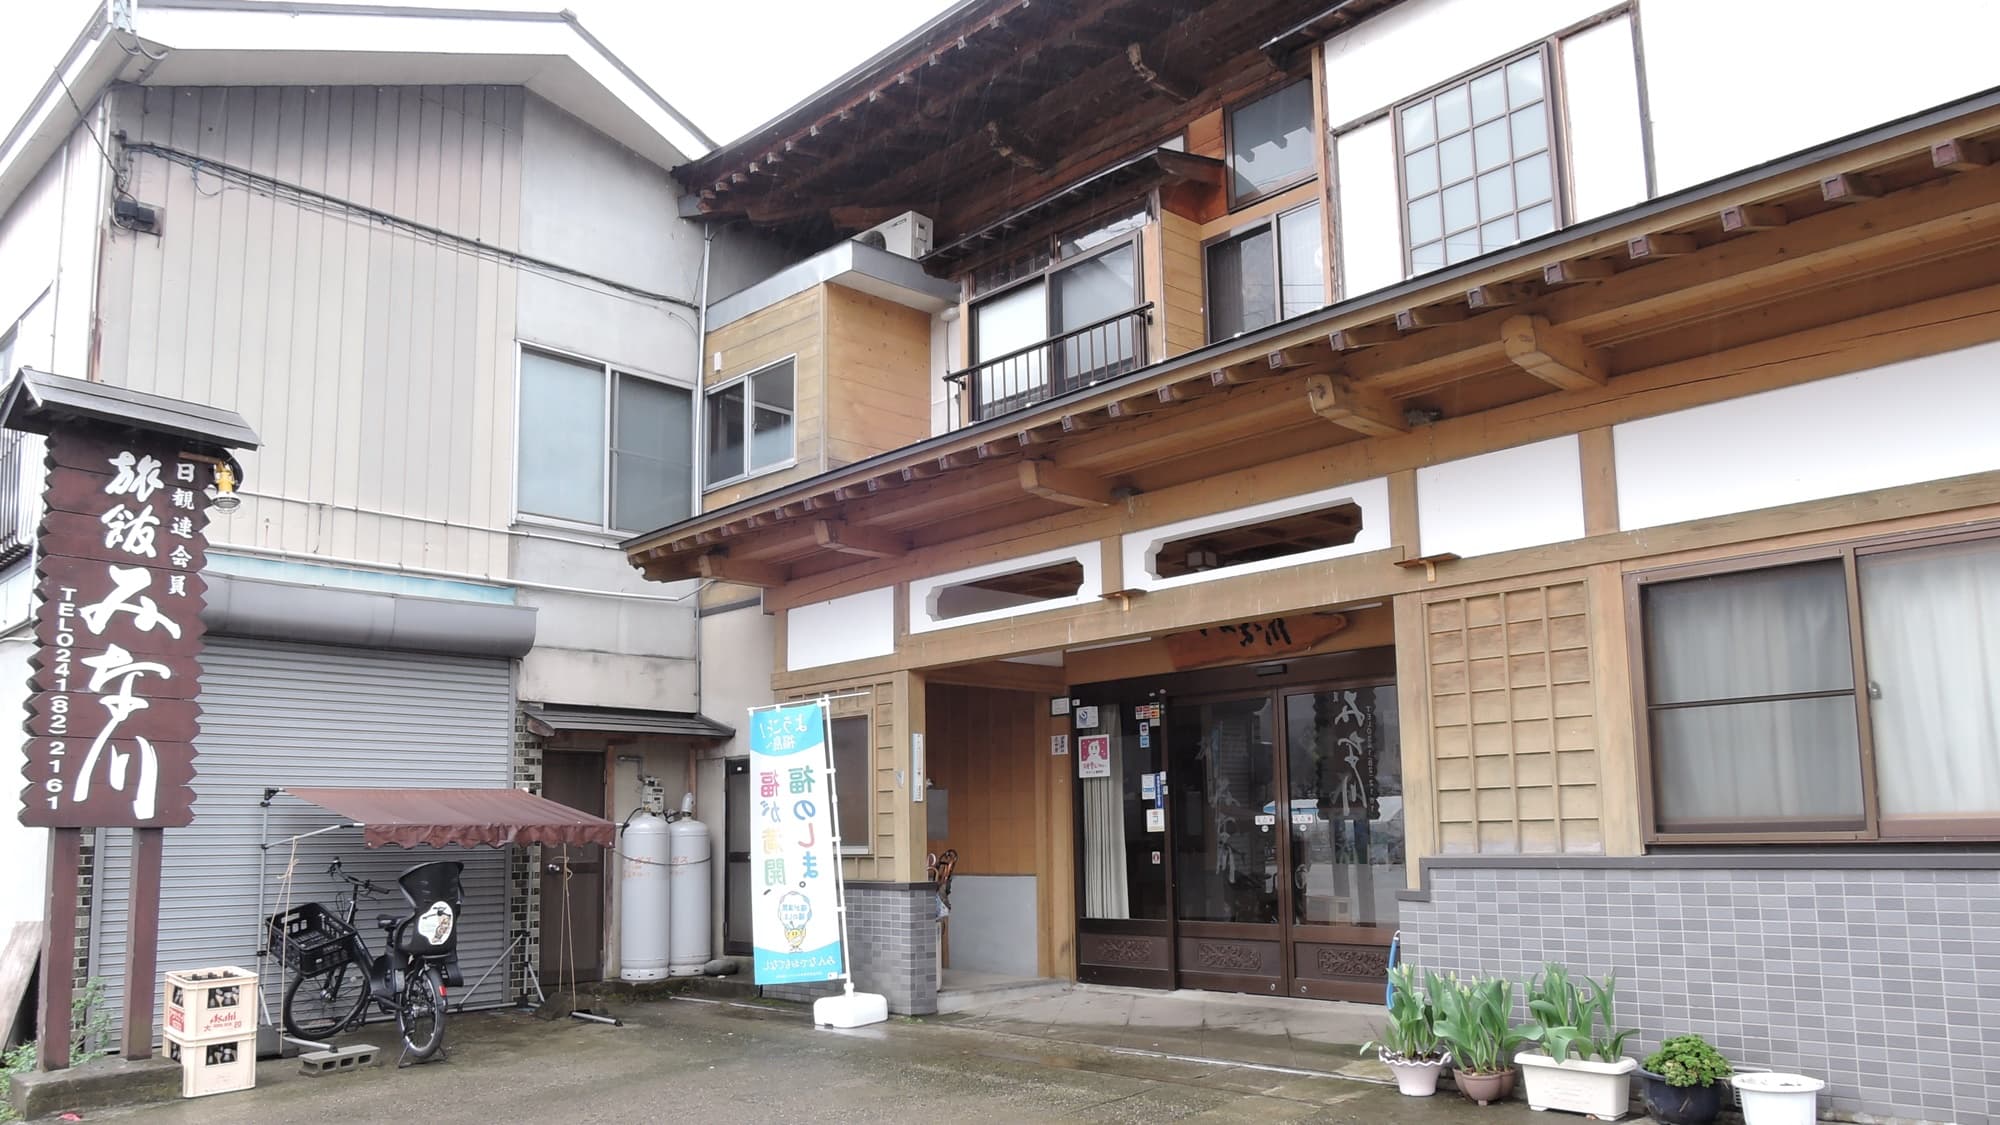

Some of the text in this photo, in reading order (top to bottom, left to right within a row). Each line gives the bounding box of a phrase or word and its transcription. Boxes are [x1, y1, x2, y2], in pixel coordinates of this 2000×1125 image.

[168, 463, 196, 598] 日観連会員
[210, 1011, 237, 1024] Asahi
